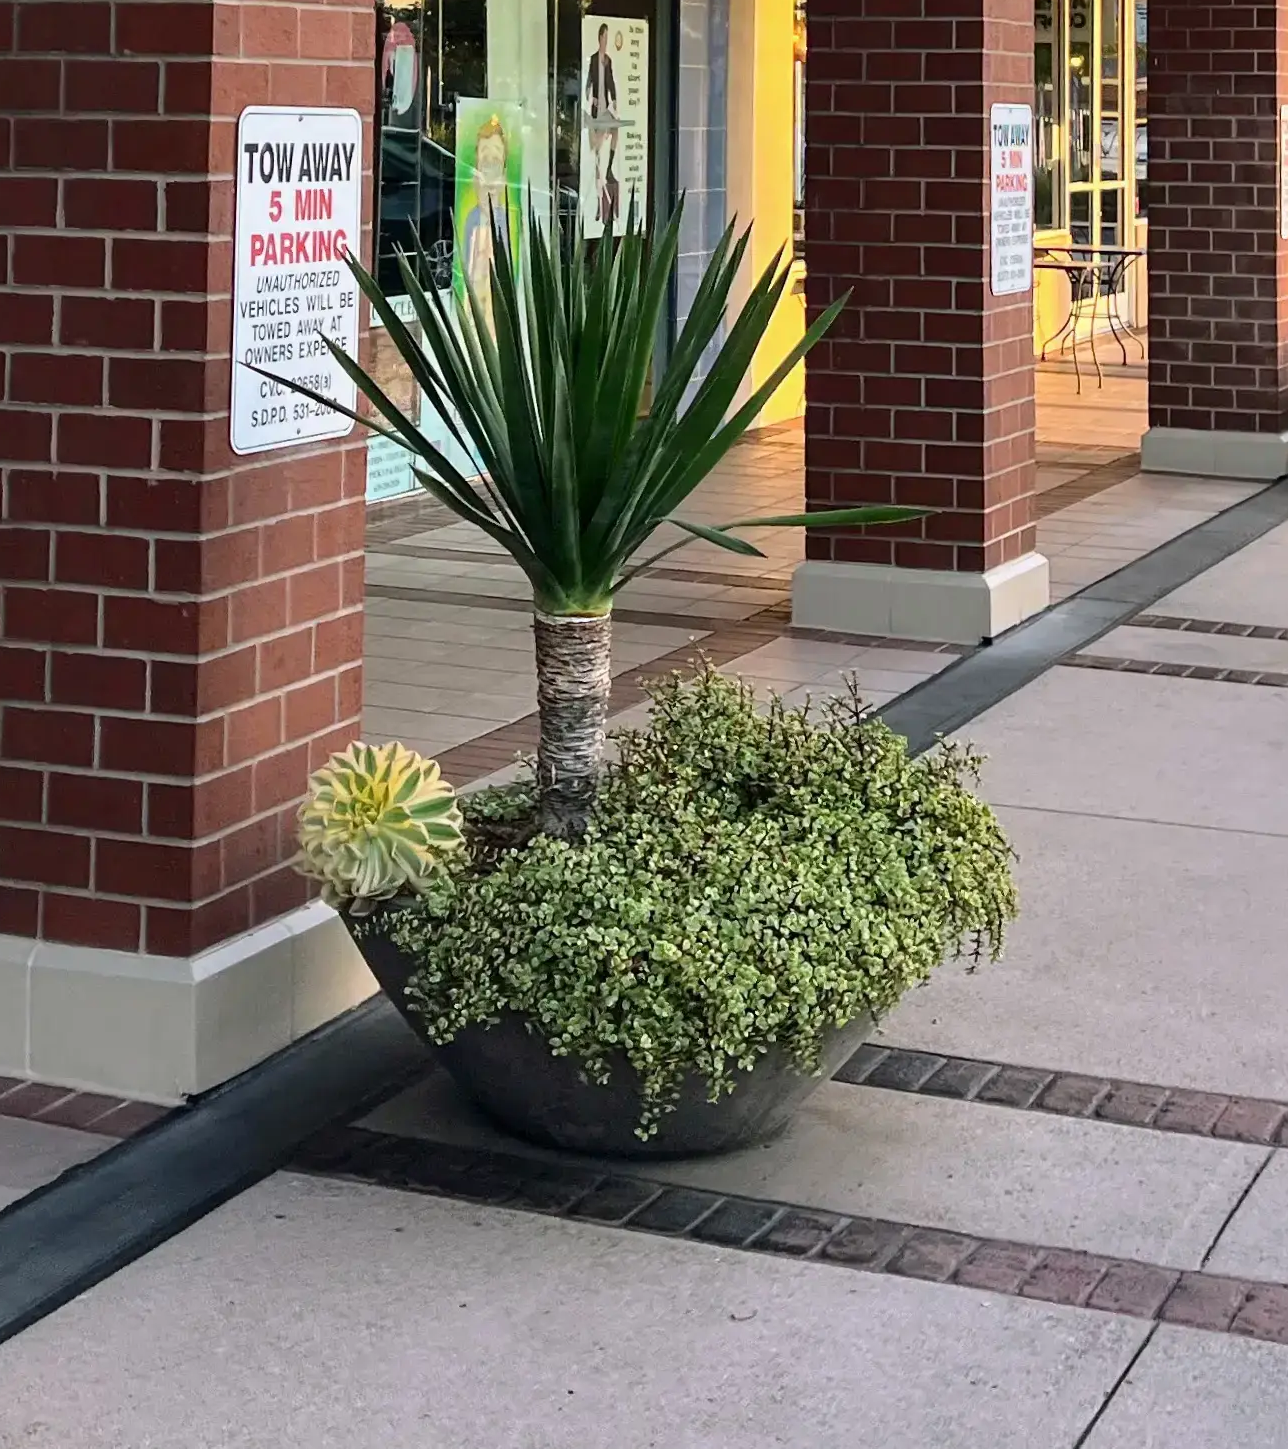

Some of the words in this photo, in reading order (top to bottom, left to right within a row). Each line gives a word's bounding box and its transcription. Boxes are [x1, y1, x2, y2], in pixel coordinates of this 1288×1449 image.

[1011, 123, 1030, 147] AWAY
[244, 142, 295, 184] TOW
[297, 142, 355, 182] AWAY
[268, 190, 283, 223] 5
[295, 188, 333, 221] MIN
[249, 229, 347, 267] PARKING
[256, 270, 340, 294] UNAUTHORIZED
[240, 296, 300, 318] VEHICLES
[306, 293, 333, 312] WILL
[339, 291, 354, 308] BE
[252, 321, 291, 342] TOWED
[296, 317, 325, 337] AWAY
[330, 315, 343, 332] AT
[245, 343, 294, 366] OWNERS
